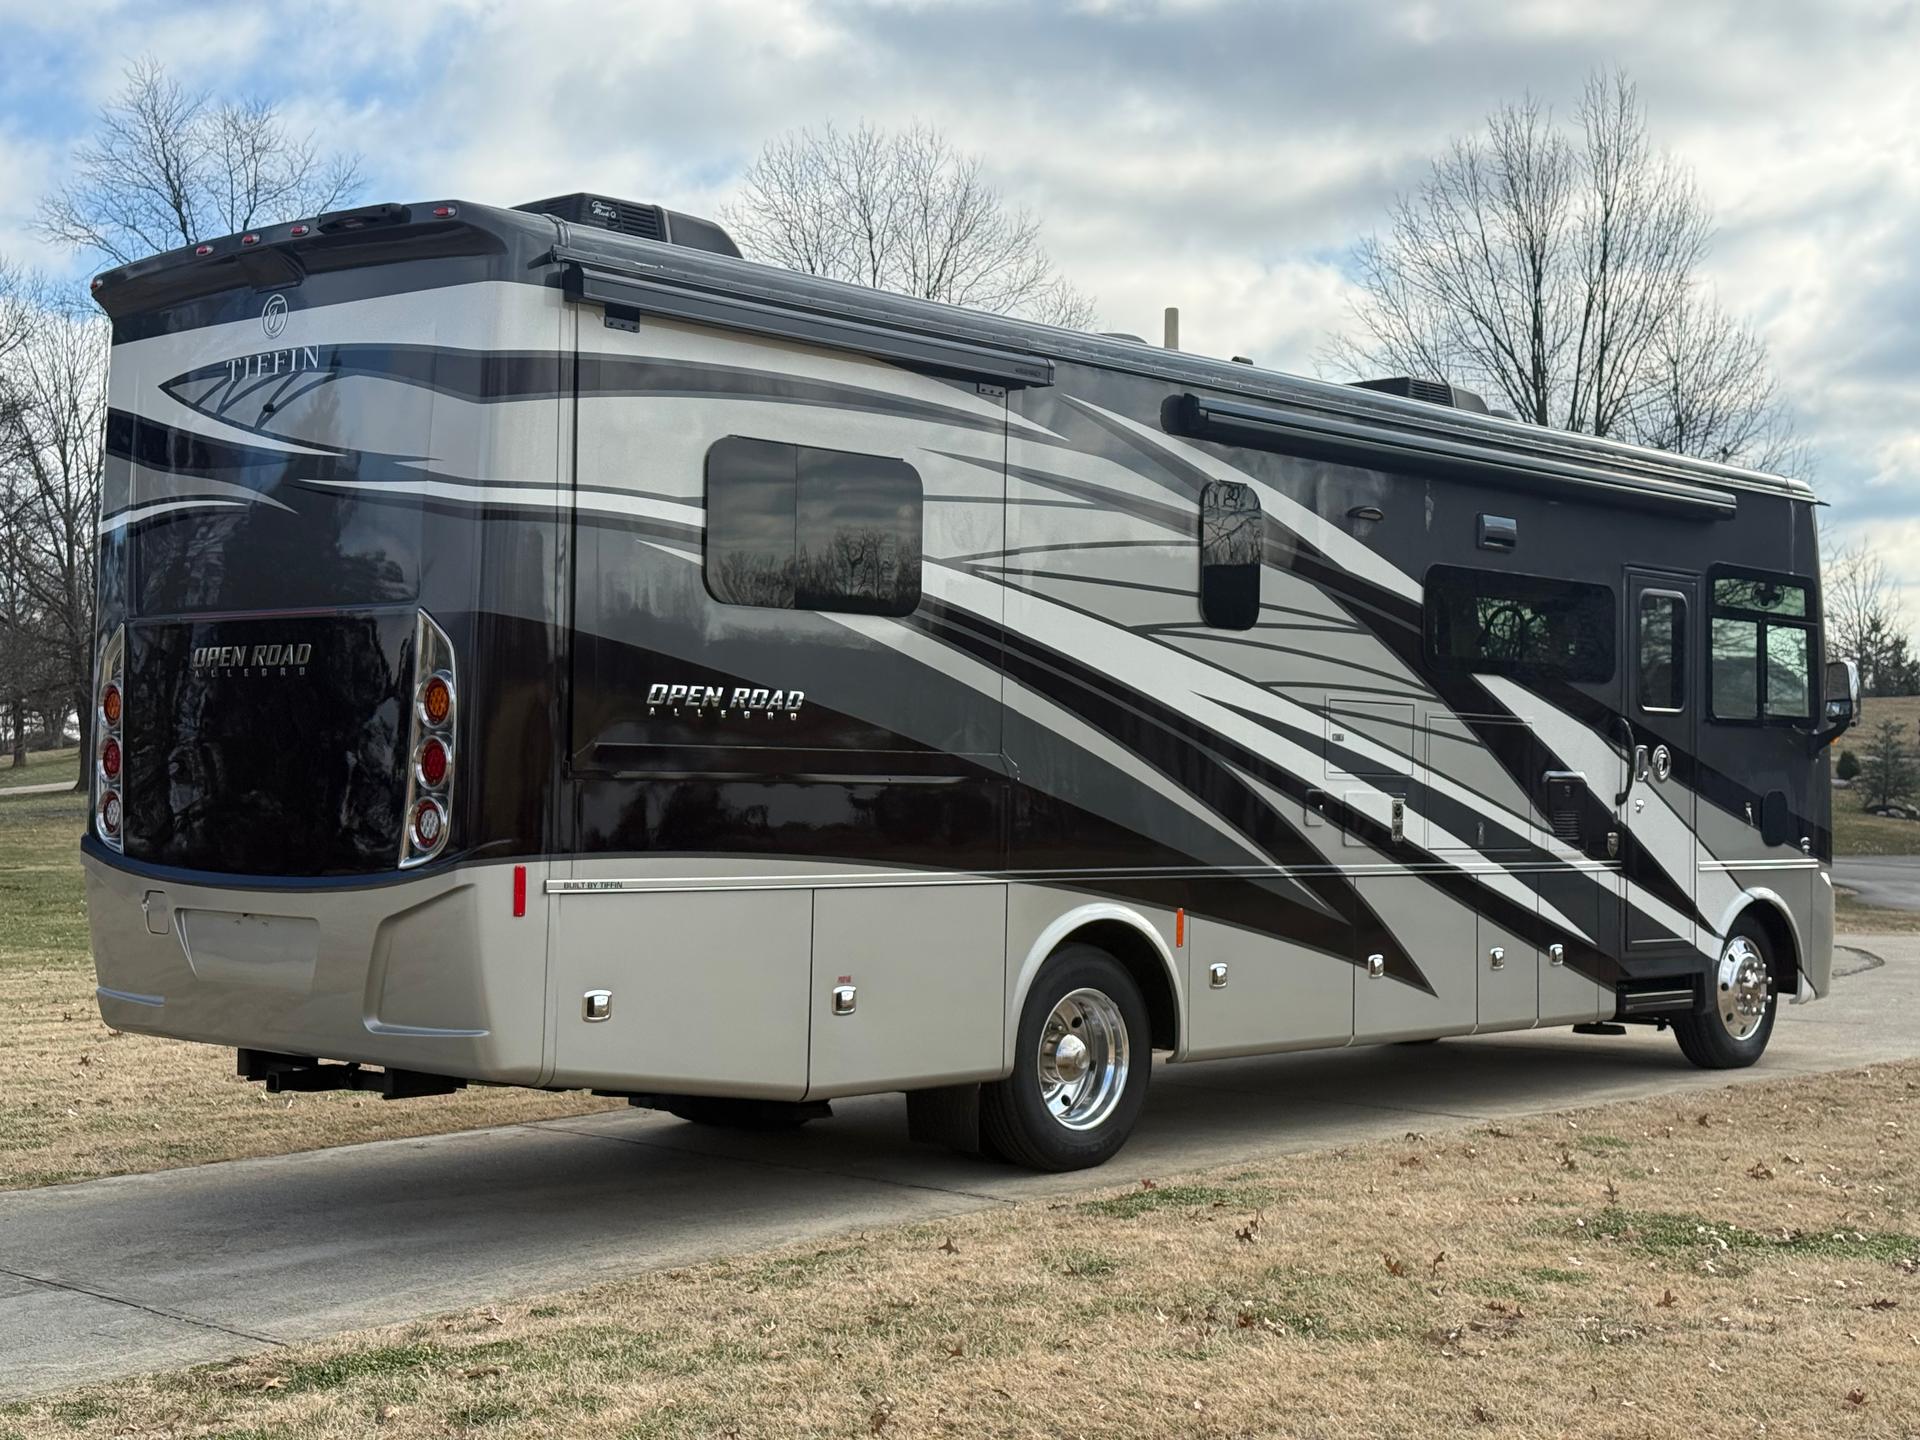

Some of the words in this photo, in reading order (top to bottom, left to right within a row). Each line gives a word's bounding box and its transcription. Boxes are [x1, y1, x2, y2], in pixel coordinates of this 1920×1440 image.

[226, 344, 319, 381] TIFFIN
[192, 646, 247, 667] OPEN
[251, 643, 311, 666] ROAD
[194, 667, 305, 677] ALLEGRO
[646, 683, 724, 708] OPEN
[729, 687, 805, 710] ROAD
[649, 707, 797, 721] ALLEGRO
[600, 881, 623, 889] TIFFIN
